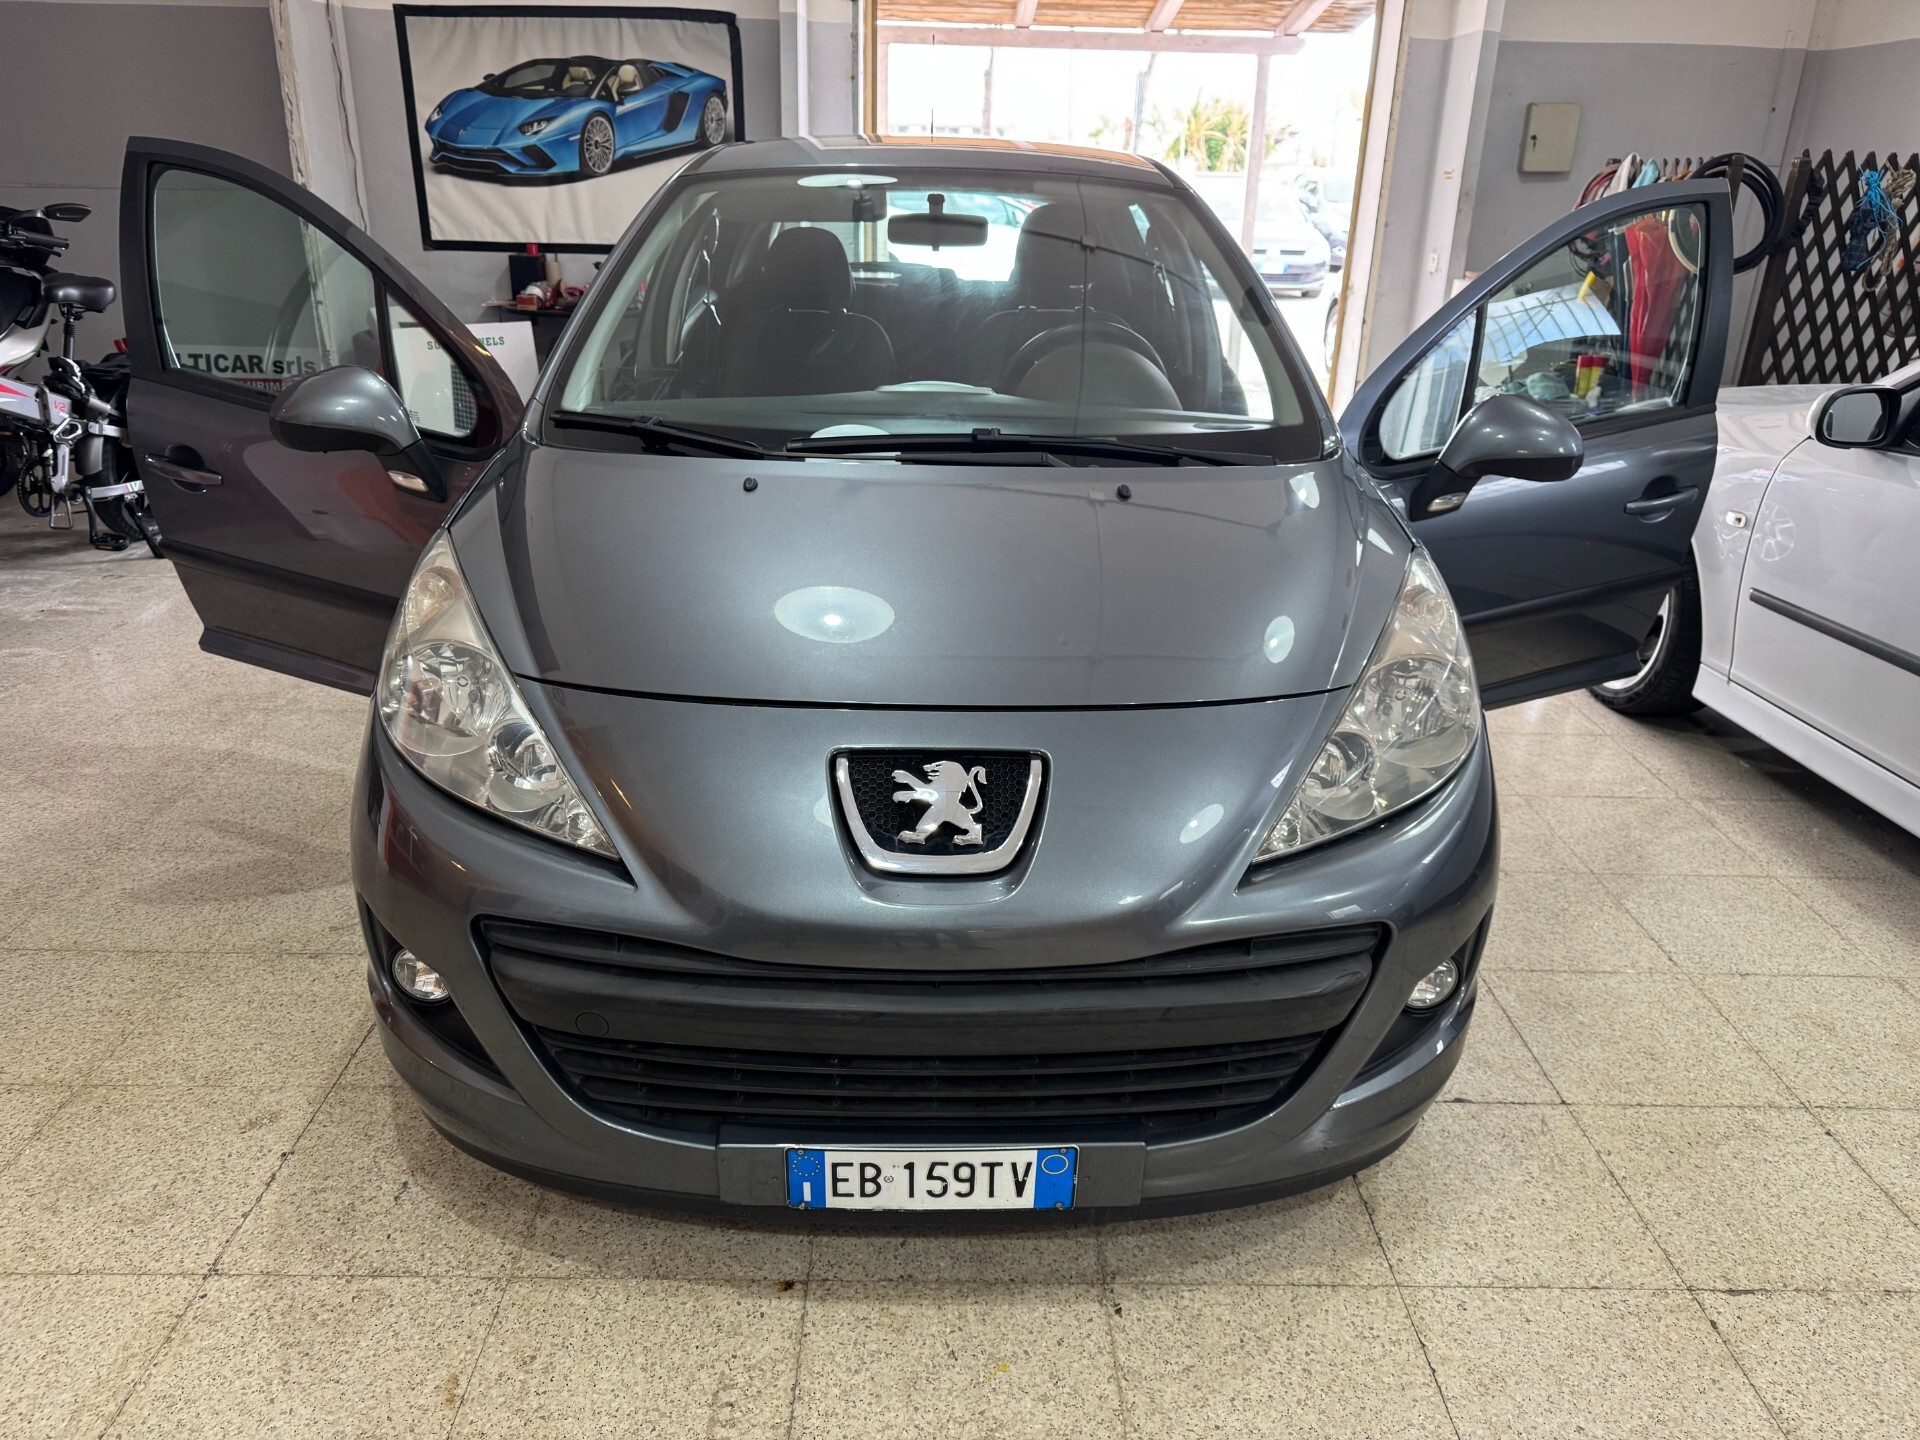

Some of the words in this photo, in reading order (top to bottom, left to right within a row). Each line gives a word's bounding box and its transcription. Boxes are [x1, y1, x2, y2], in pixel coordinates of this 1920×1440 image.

[272, 356, 317, 375] srls
[831, 1161, 882, 1198] EB
[903, 1161, 1033, 1199] 159TV
